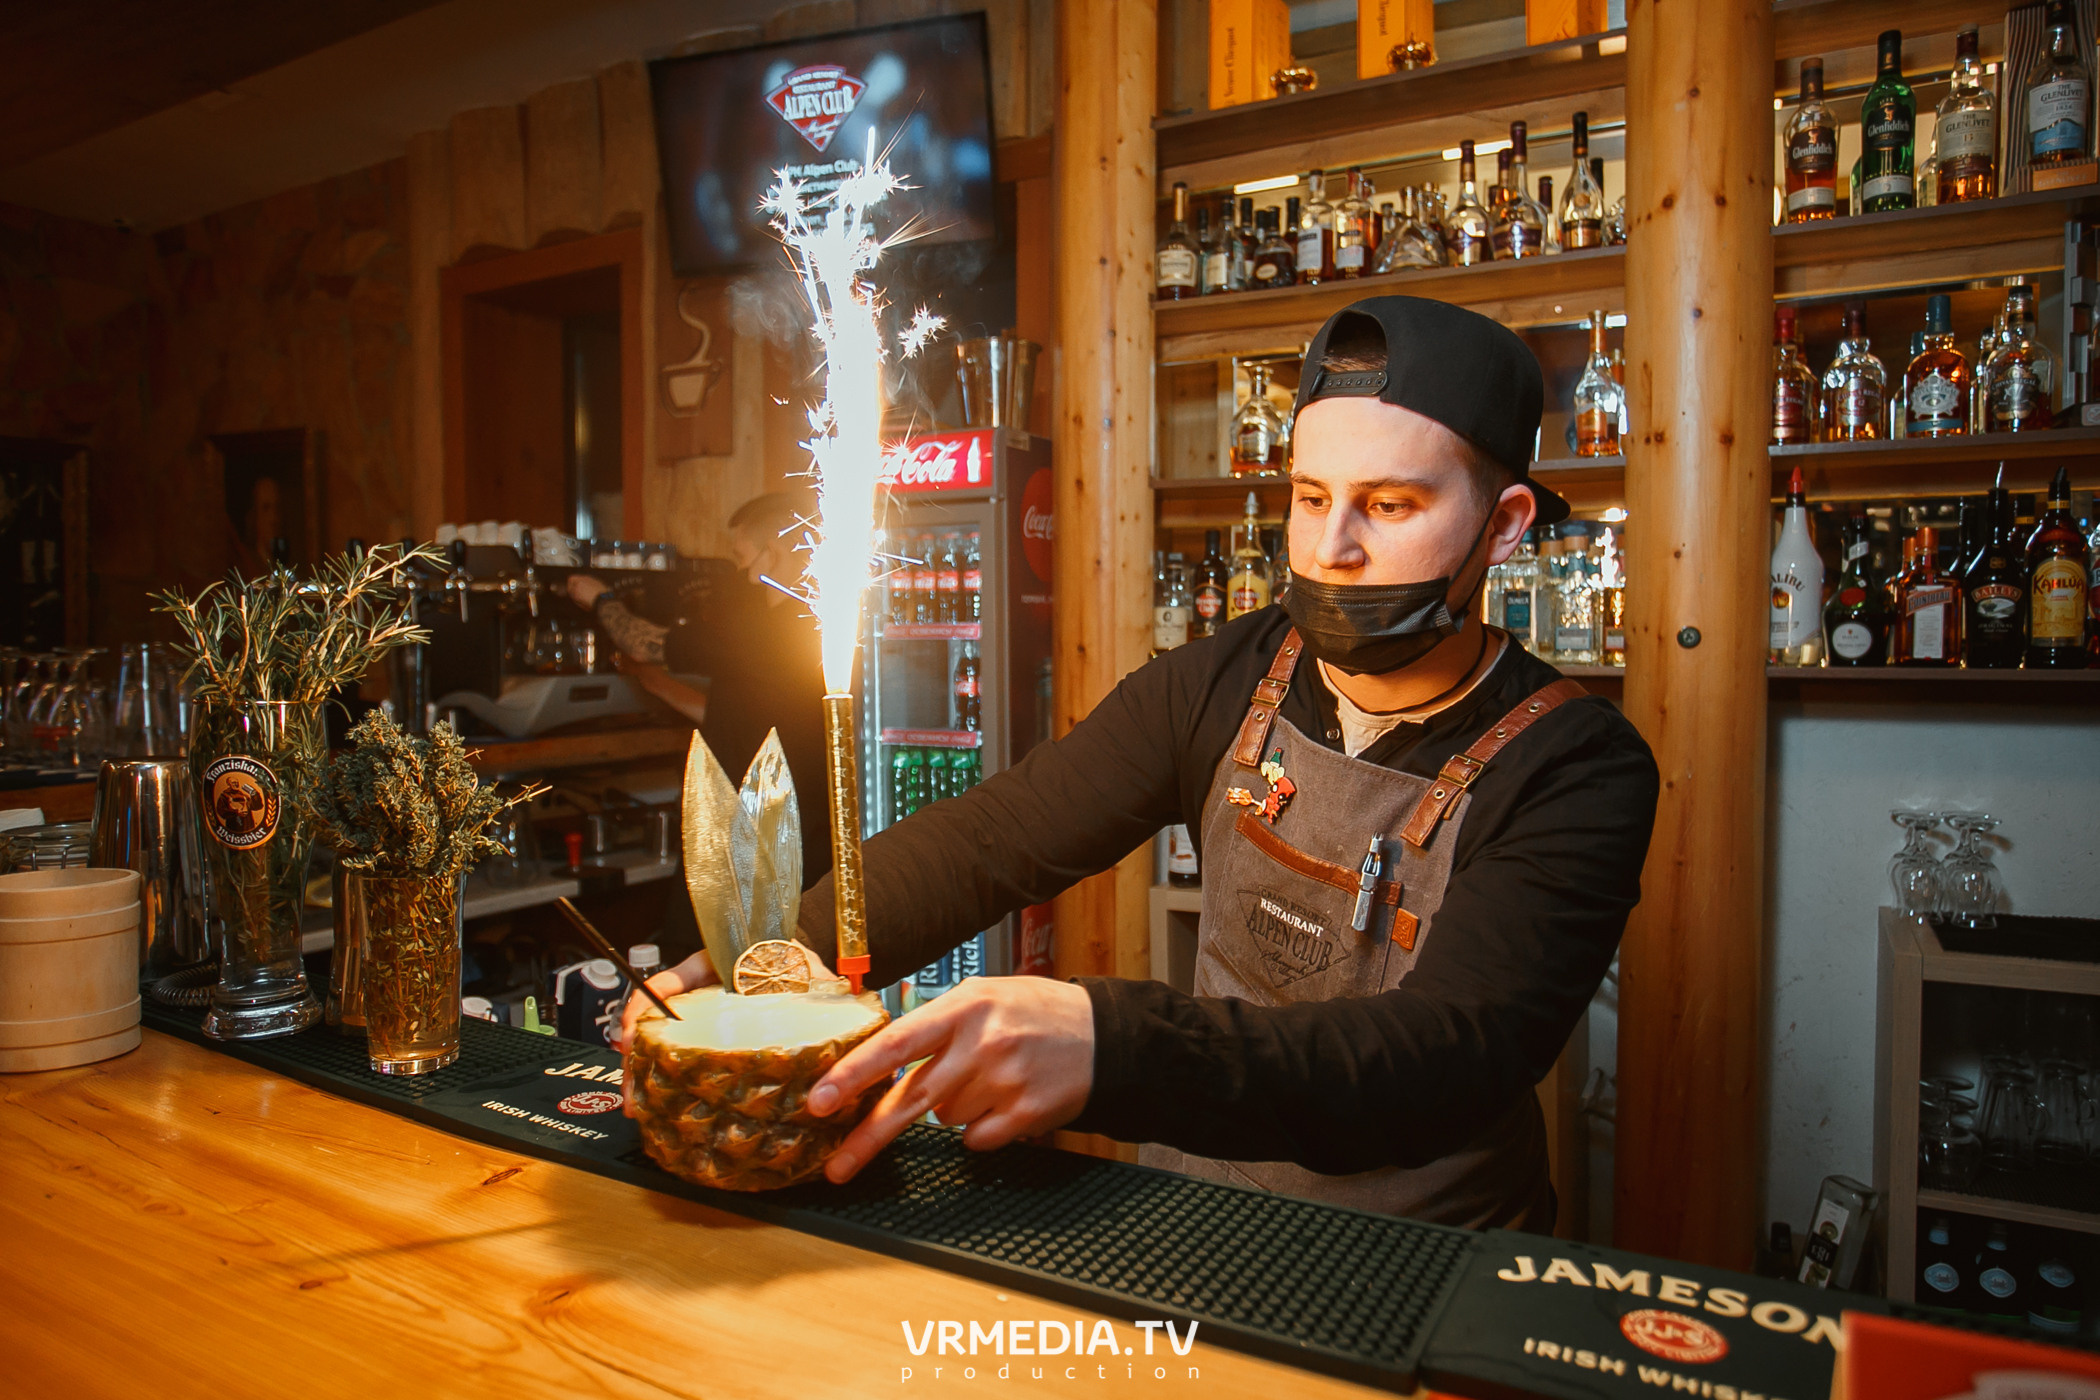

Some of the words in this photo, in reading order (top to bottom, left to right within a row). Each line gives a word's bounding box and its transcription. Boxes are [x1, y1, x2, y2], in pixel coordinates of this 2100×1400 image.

[783, 93, 822, 121] ALPEN
[821, 85, 855, 116] CLUB
[1867, 119, 1910, 138] Glenfiddich
[1792, 143, 1833, 160] Glenfiddich
[803, 163, 834, 179] Alpen
[834, 158, 859, 174] Club
[1770, 573, 1806, 592] ALIBU
[1973, 585, 2018, 598] BAILEYS
[216, 825, 267, 845] Weissbier
[1260, 897, 1324, 938] RESTAURANT
[1261, 888, 1288, 908] GRAND
[1290, 901, 1327, 926] RESORT
[1247, 902, 1292, 951] ALPEN
[1292, 932, 1333, 971] CLUB
[482, 1100, 531, 1118] IRISH
[528, 1114, 609, 1140] WHISKEY
[1522, 1337, 1628, 1377] IRISH
